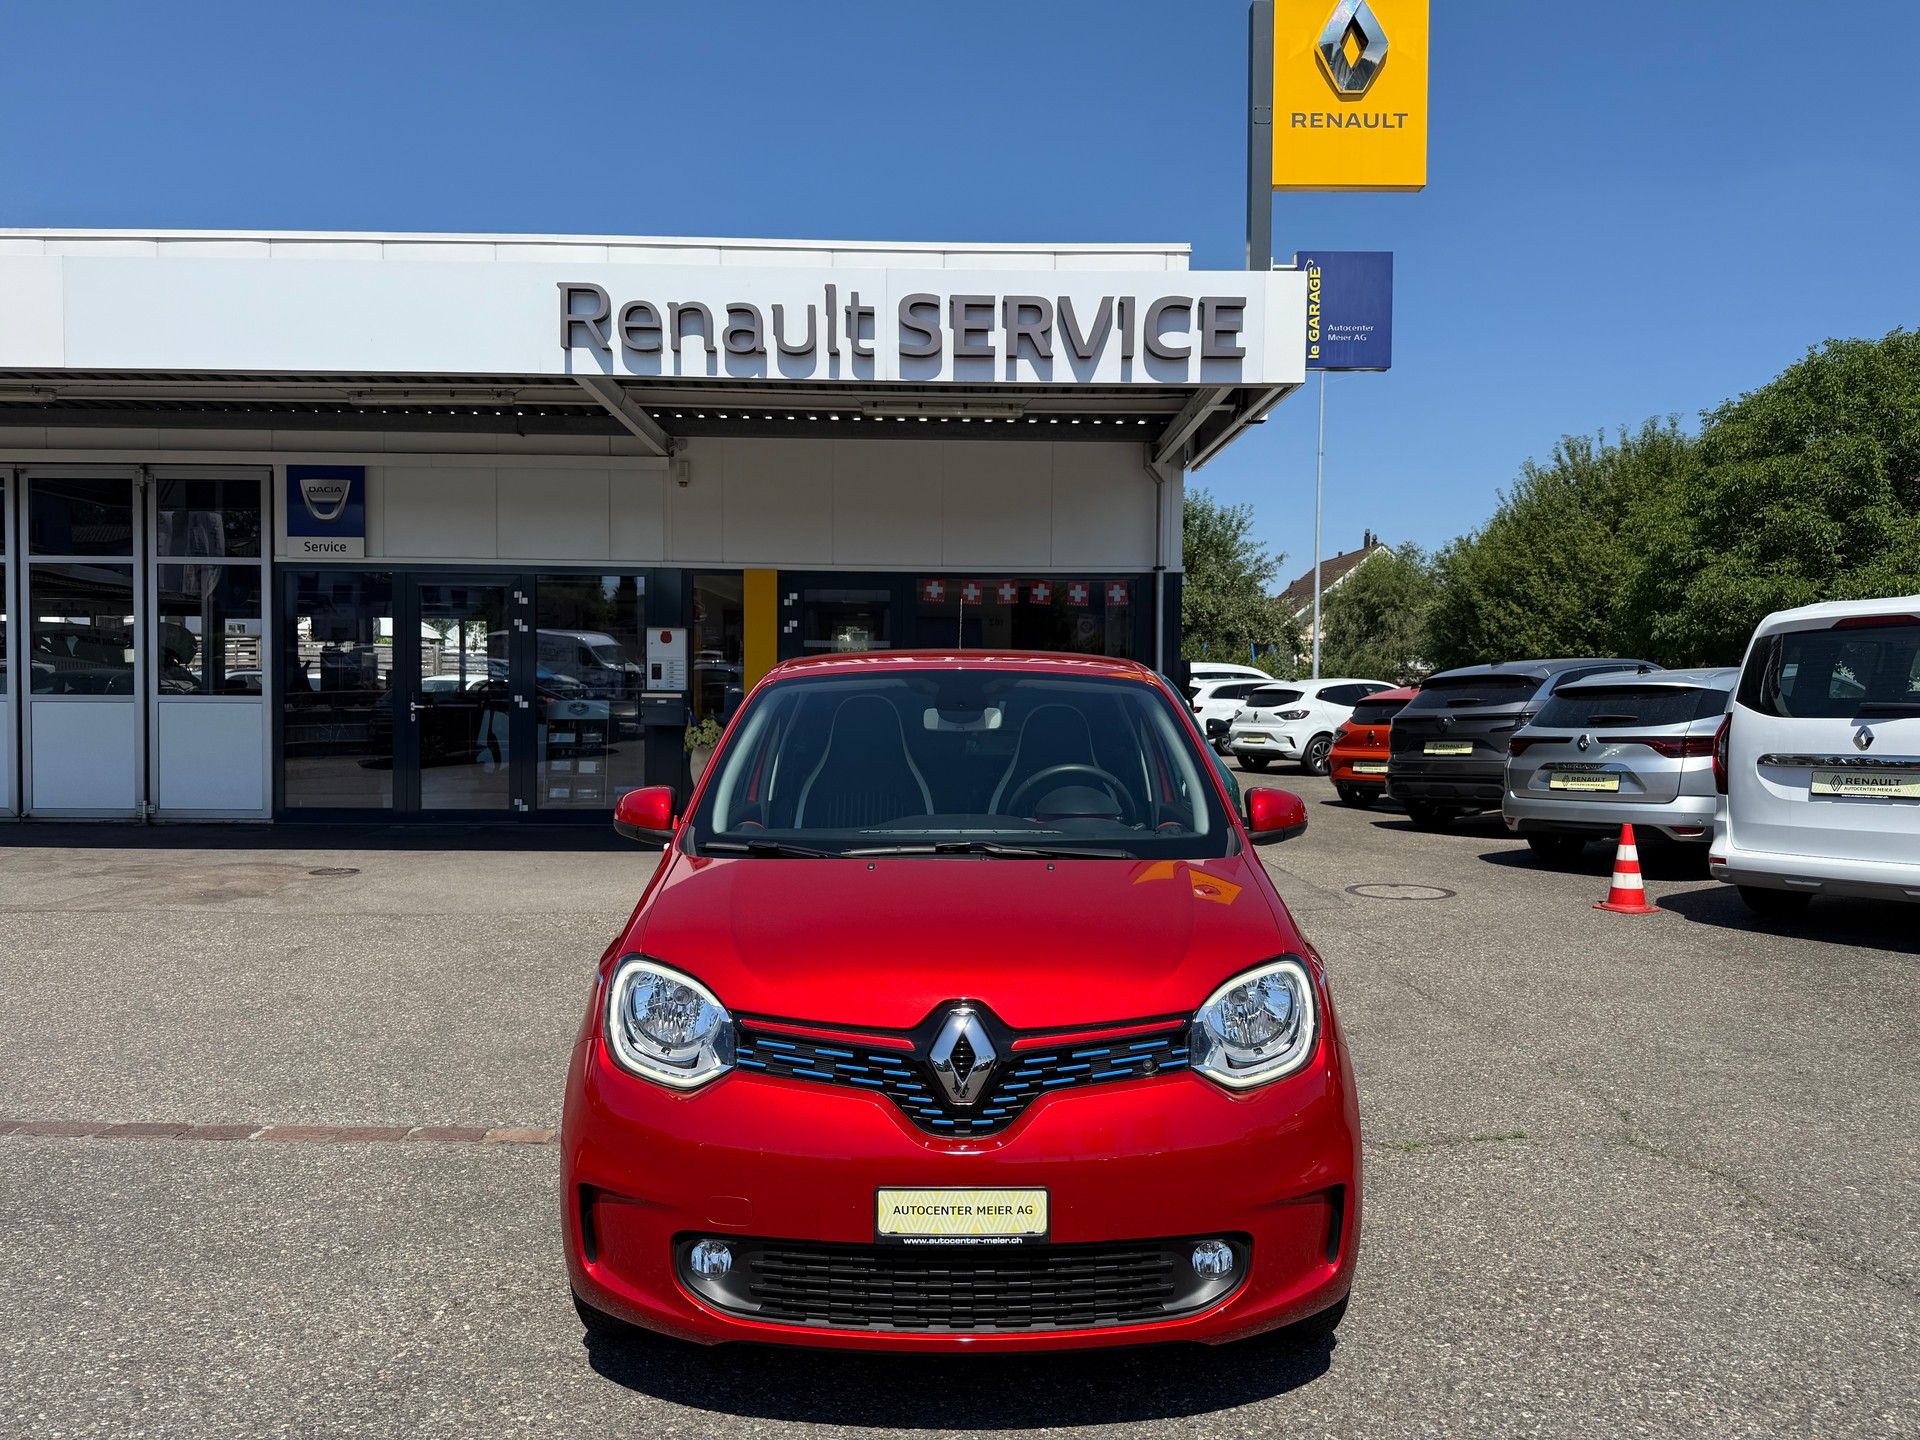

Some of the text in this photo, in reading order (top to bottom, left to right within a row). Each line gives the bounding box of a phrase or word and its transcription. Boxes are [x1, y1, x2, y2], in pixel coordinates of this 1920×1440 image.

[1291, 113, 1408, 129] RENAULT
[1308, 266, 1321, 359] le GARAGE
[556, 282, 1247, 361] Renault SERVICE
[1327, 324, 1374, 332] Autocenter
[304, 541, 347, 552] Service
[1845, 777, 1902, 786] RENAULT
[893, 1205, 1033, 1215] AUTOCENTER MEIER AG
[903, 1237, 1023, 1245] www.autocenter-meier.ch
